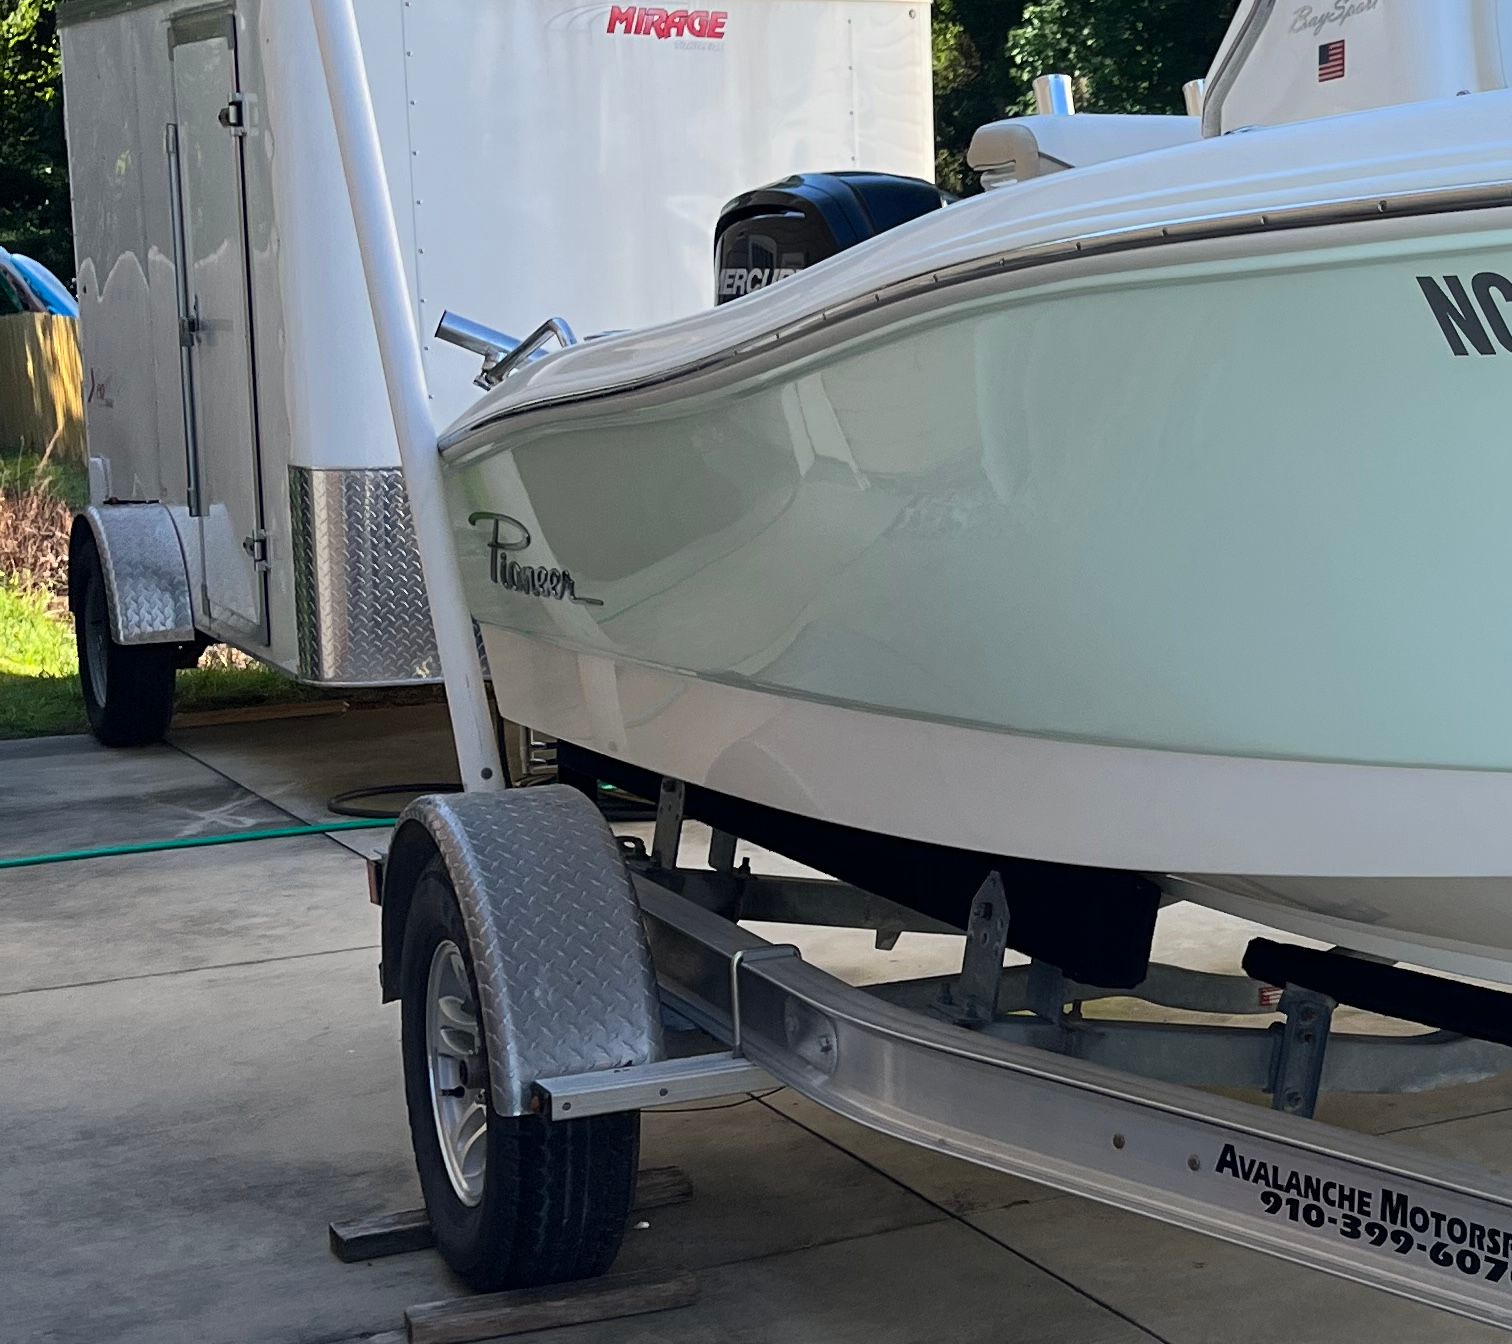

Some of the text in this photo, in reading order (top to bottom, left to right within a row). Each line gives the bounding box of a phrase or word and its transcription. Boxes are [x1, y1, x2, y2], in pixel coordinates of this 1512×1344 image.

[606, 5, 728, 39] MIRAGE
[468, 511, 604, 606] Pioneer
[1215, 1143, 1373, 1218] AVALANCHE
